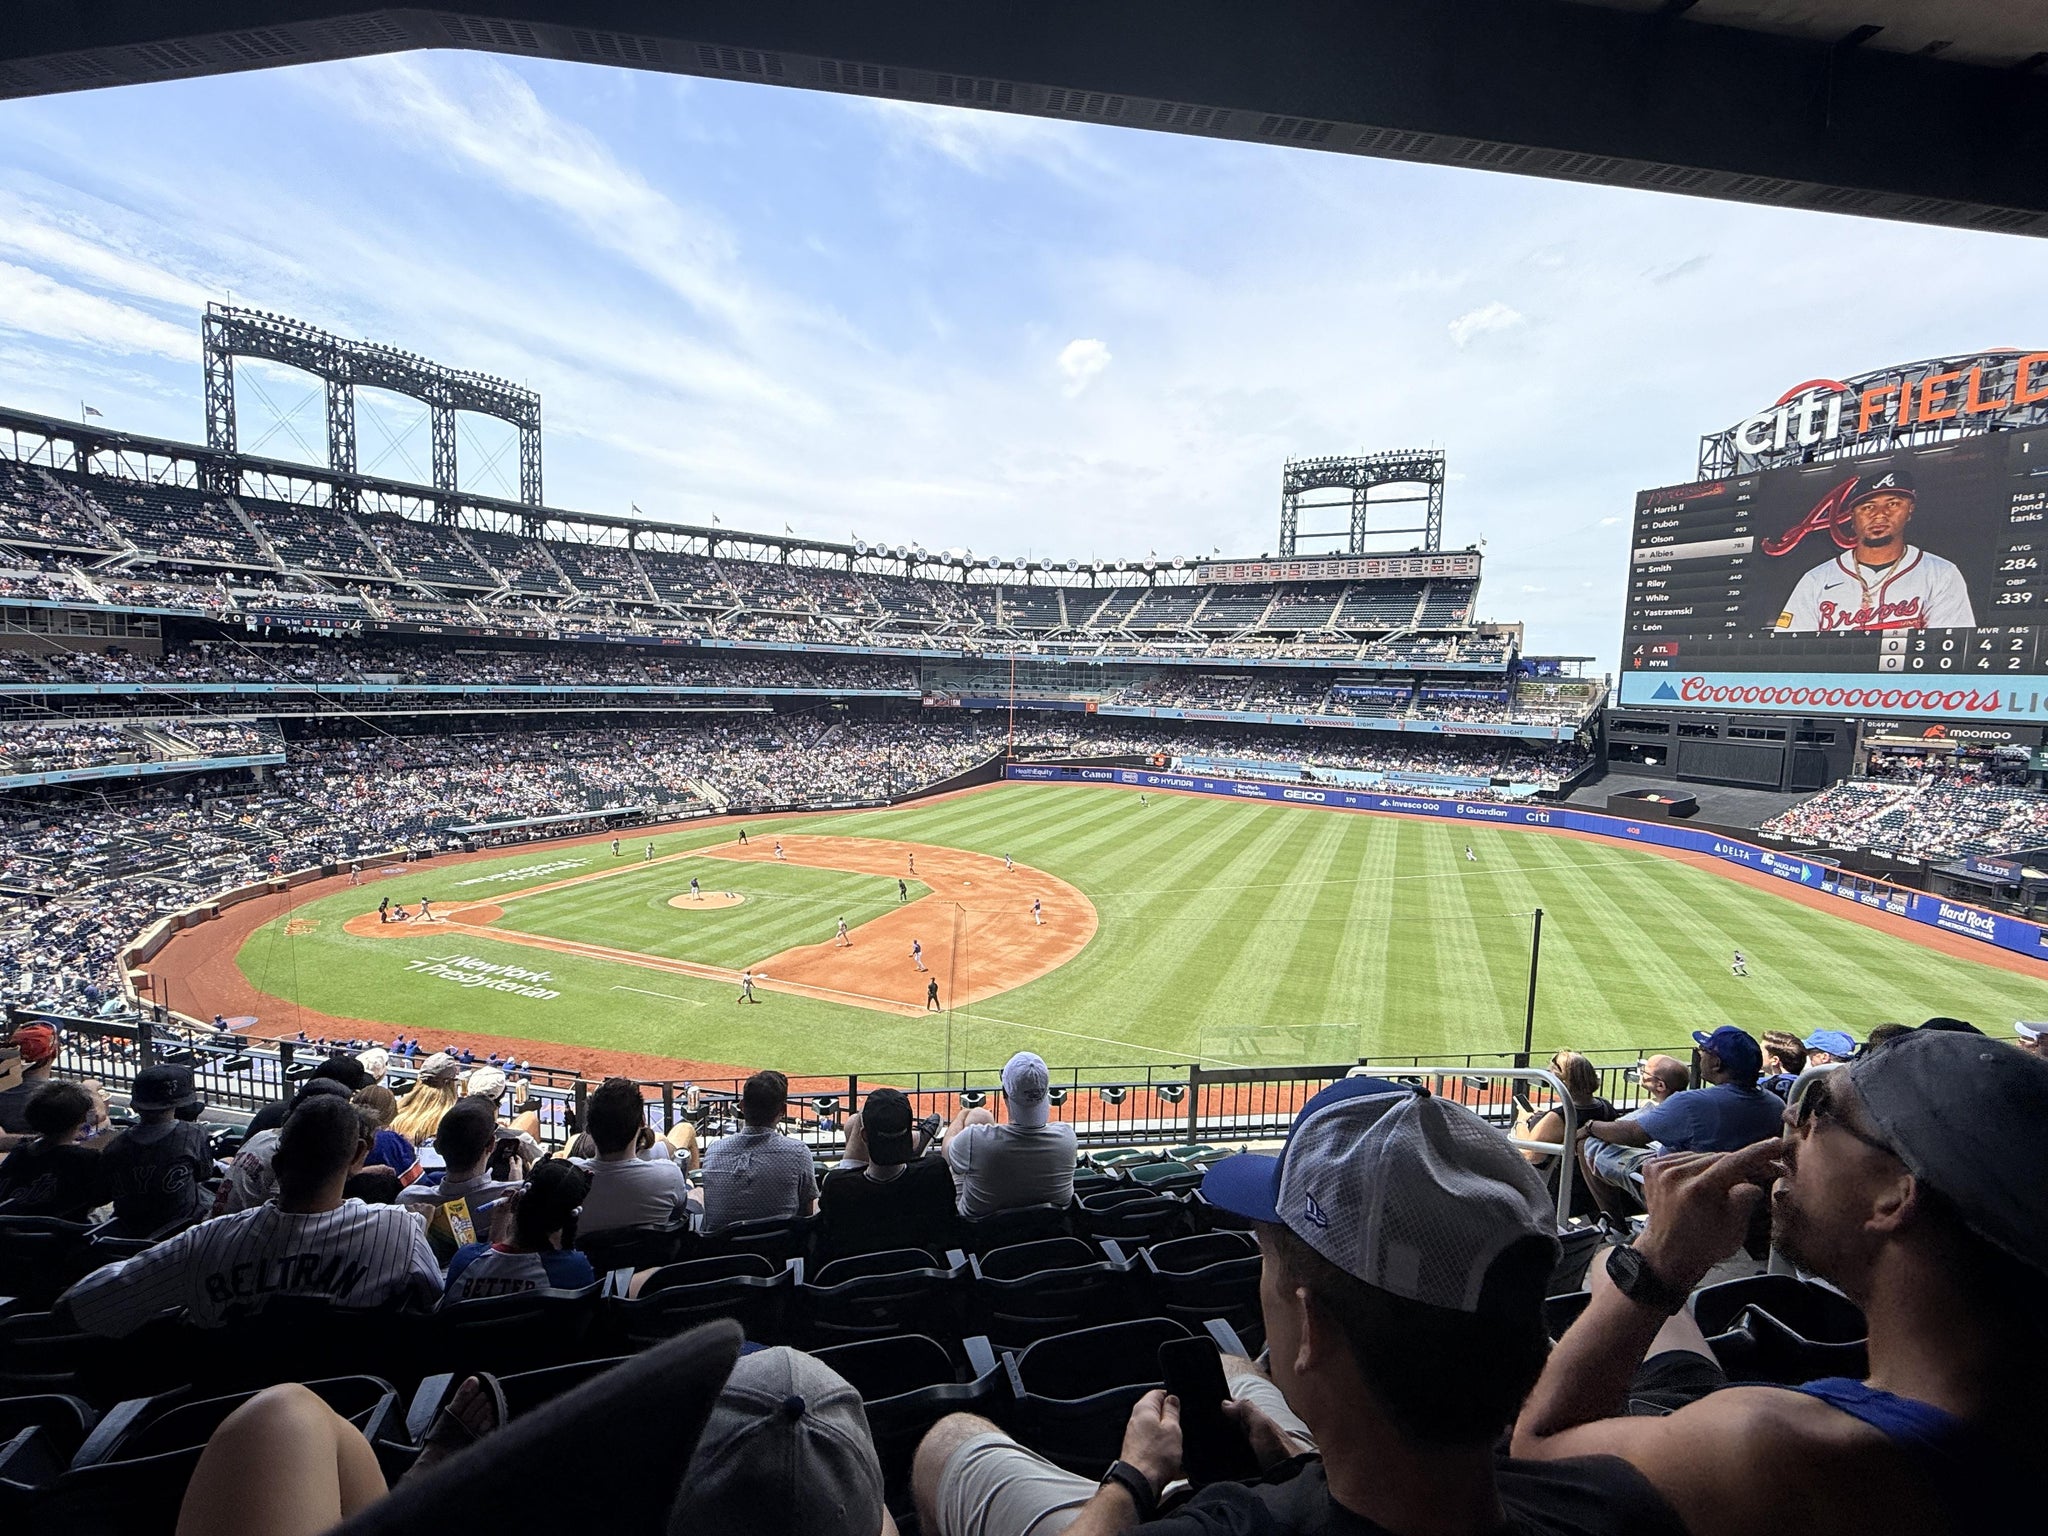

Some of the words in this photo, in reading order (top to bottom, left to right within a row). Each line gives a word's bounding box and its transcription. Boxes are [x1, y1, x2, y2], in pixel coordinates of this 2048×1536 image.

[1736, 391, 1842, 454] citi
[2012, 494, 2035, 502] Has
[1654, 505, 1677, 514] Harris
[2011, 502, 2042, 514] pond
[2010, 513, 2043, 523] tanks
[1652, 520, 1679, 529] Dubón
[1651, 536, 1674, 544] Olson
[1650, 550, 1674, 558] Albies
[1648, 564, 1672, 573] Smith
[2000, 558, 2038, 570] .284
[1996, 592, 2032, 604] .339
[1644, 607, 1693, 616] Yastrzemski
[1819, 597, 1920, 631] Braves
[1889, 641, 1899, 650] 0
[1916, 640, 1926, 650] 3
[1942, 640, 1954, 650] 0
[1980, 639, 1992, 650] 4
[2011, 638, 2023, 650] 2
[1887, 659, 1897, 668] 0
[1913, 658, 1924, 668] 0
[1940, 658, 1951, 669] 0
[1978, 658, 1989, 669] 4
[2008, 658, 2020, 669] 2
[2008, 692, 2048, 712] LI
[1950, 729, 2012, 739] moomoo
[1015, 768, 1053, 777] HealthEquity
[1082, 770, 1112, 779] Canon
[1161, 778, 1193, 787] HYUNDAI
[1283, 790, 1325, 802] GEICO
[1392, 800, 1421, 808] Invesco
[1422, 802, 1439, 811] QQQ
[1466, 807, 1507, 817] Guardian
[1526, 811, 1550, 823] citi
[1722, 844, 1750, 860] DELTA
[1773, 868, 1790, 878] GROUP
[1977, 863, 2009, 876] $23,275
[1821, 882, 1833, 892] 380
[1939, 904, 1967, 922] Hard
[1967, 911, 1995, 933] Rock
[417, 963, 560, 999] Presbyterian
[205, 1252, 368, 1303] BELTRAN
